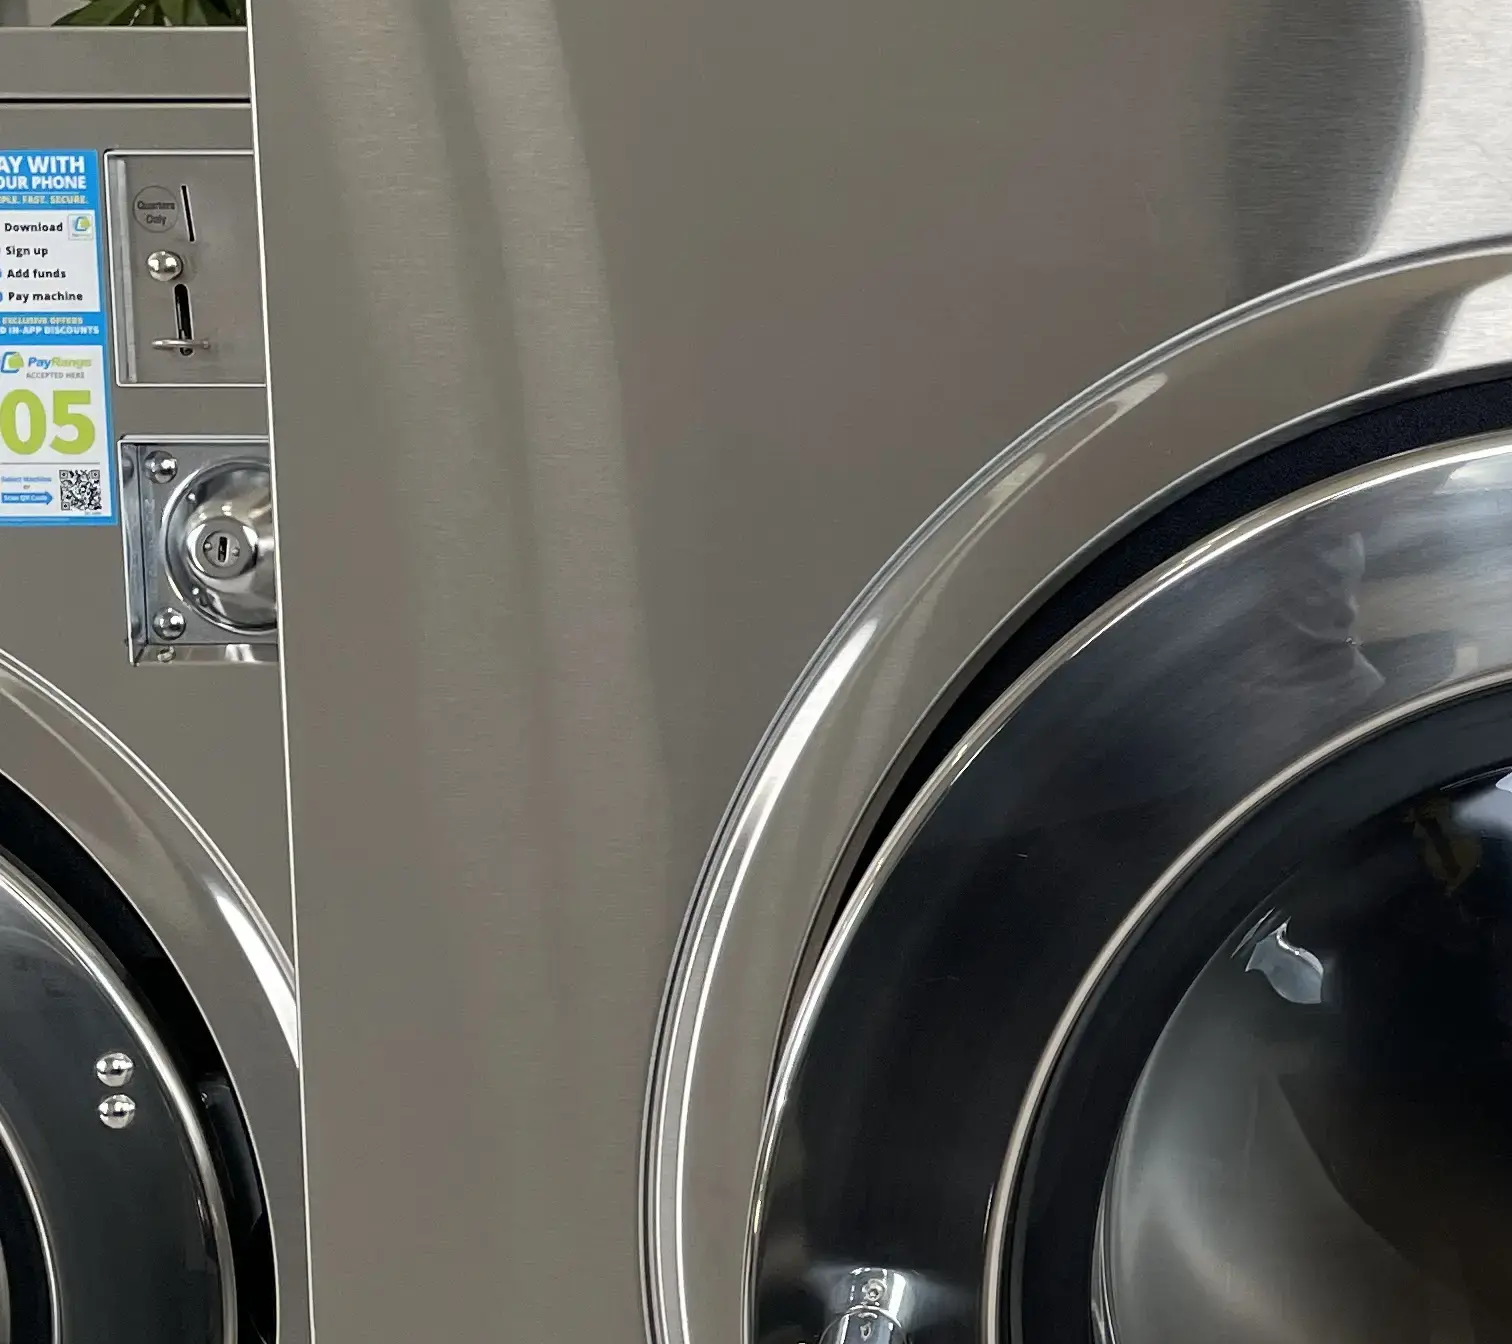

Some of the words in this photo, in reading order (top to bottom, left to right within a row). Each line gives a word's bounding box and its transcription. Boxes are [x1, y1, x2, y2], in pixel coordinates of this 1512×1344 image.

[0, 155, 23, 174] AY
[27, 155, 85, 174] WITH
[32, 175, 87, 189] PHONE
[4, 221, 64, 232] Download
[6, 246, 31, 258] Sign
[34, 247, 49, 258] up
[7, 269, 30, 279] Add
[33, 269, 67, 279] funds
[8, 292, 30, 304] Pay
[33, 291, 84, 301] machine
[44, 326, 100, 335] DISCOUNTS
[28, 356, 92, 370] PayRange
[0, 389, 96, 456] 05
